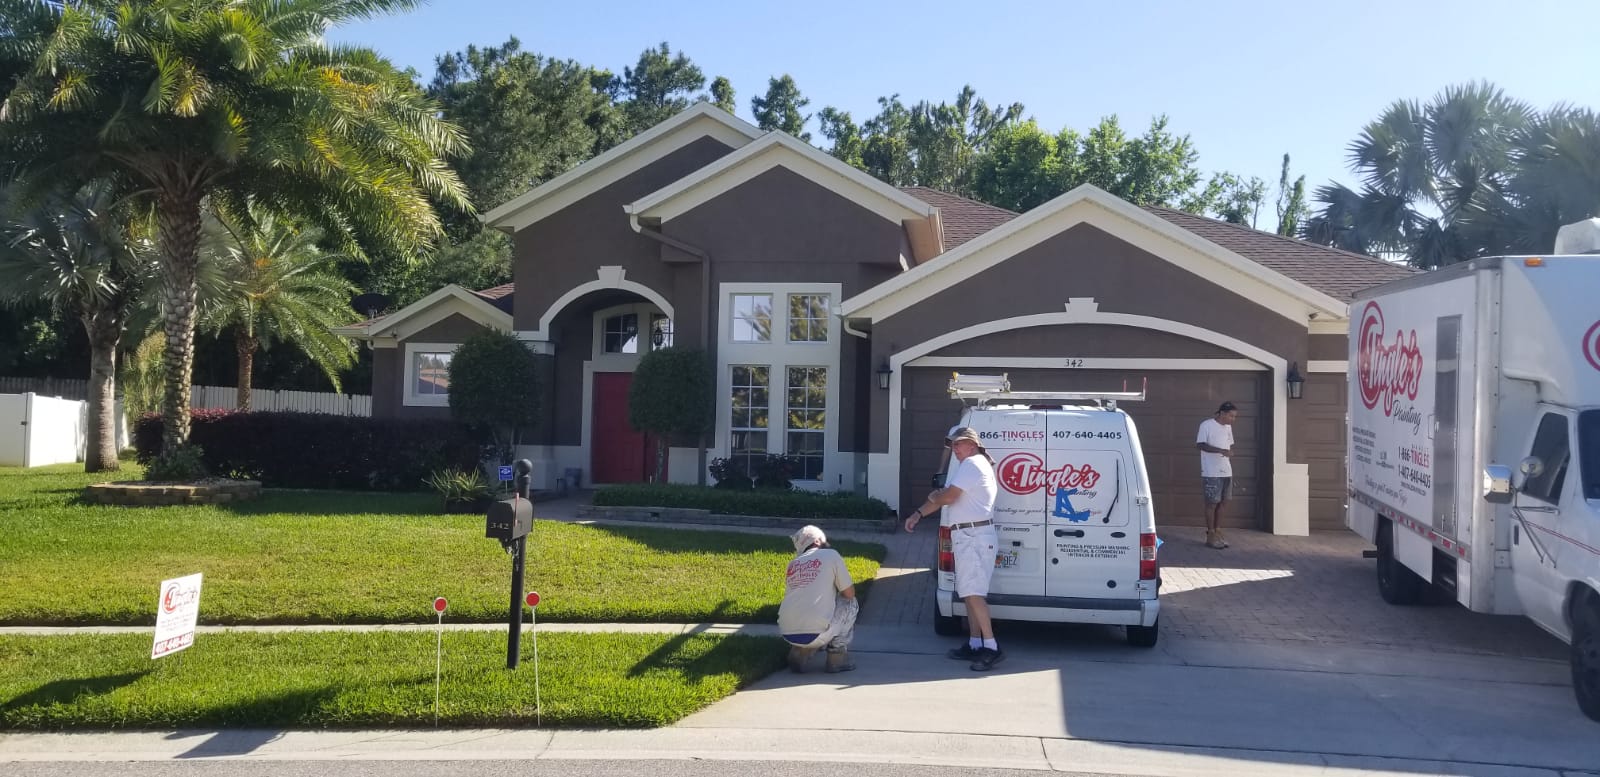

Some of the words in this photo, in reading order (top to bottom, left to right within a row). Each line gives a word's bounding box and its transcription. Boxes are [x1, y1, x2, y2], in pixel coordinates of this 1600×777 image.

[1064, 358, 1083, 367] 342
[1392, 399, 1422, 436] Painting
[979, 430, 1044, 440] 866-TINGLES
[1052, 430, 1122, 440] 407-640-4405
[997, 452, 1100, 495] Tingle's
[490, 522, 510, 530] 342
